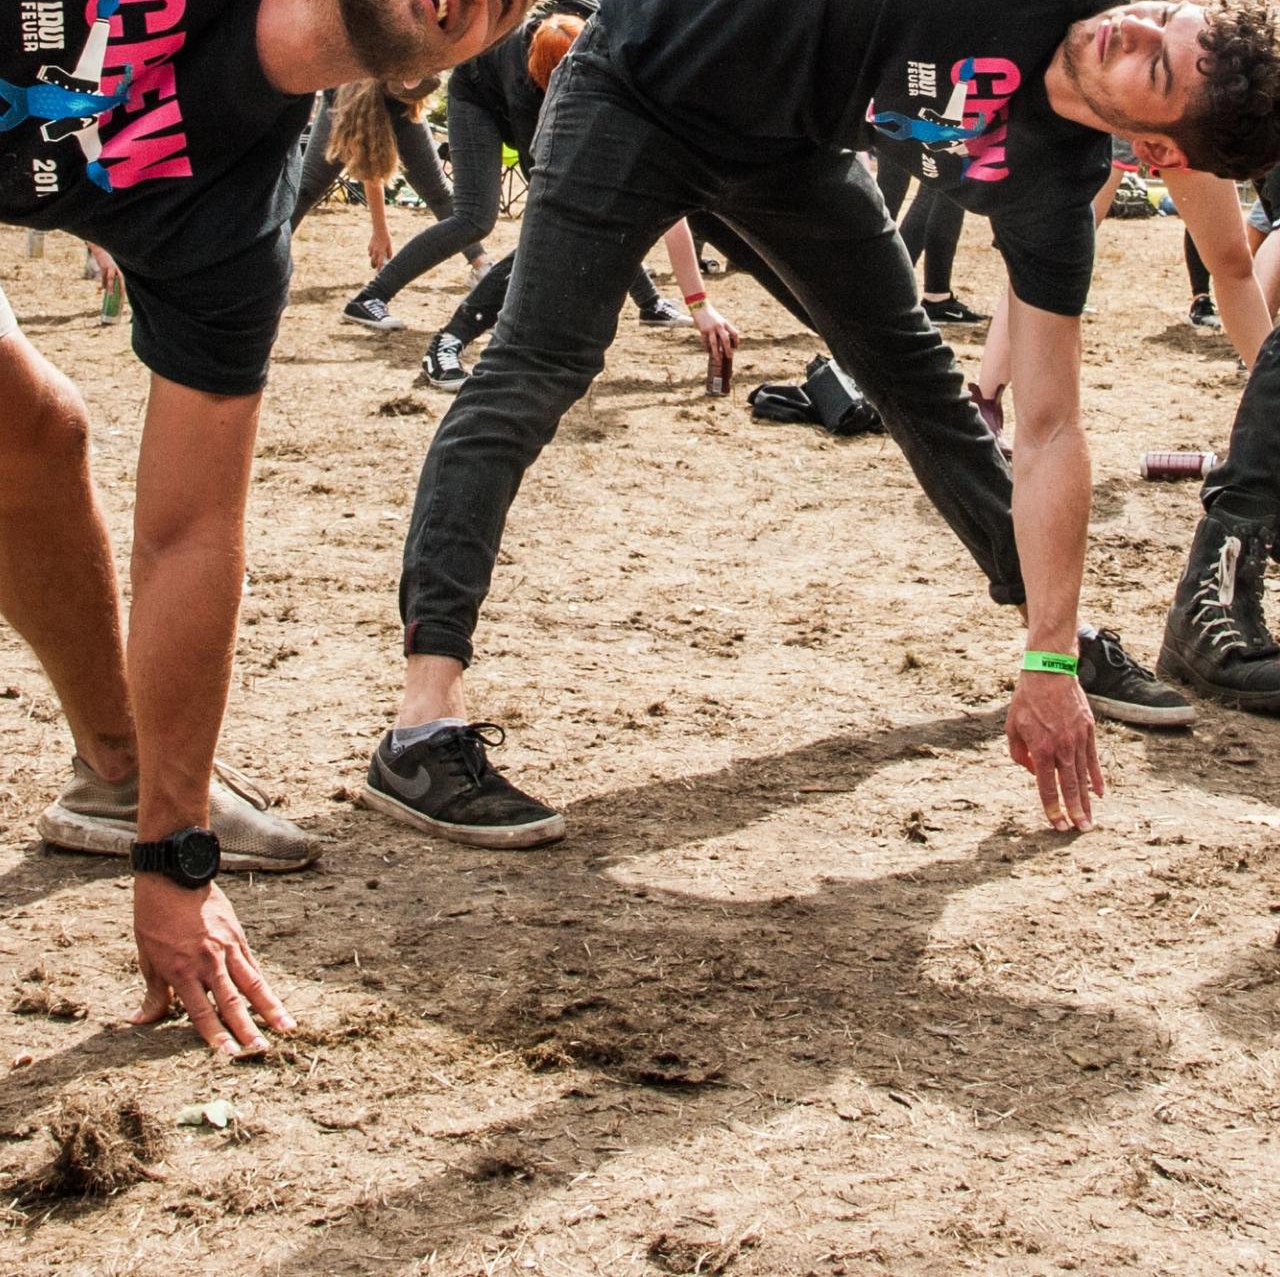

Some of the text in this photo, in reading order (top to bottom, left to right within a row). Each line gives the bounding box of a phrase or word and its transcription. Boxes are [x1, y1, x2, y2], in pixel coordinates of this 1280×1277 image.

[20, 1, 38, 52] FEUER
[38, 0, 65, 50] LAUT
[907, 60, 919, 97] FEUER
[919, 62, 938, 98] LAUT
[32, 158, 59, 198] 201
[921, 152, 940, 179] 2019
